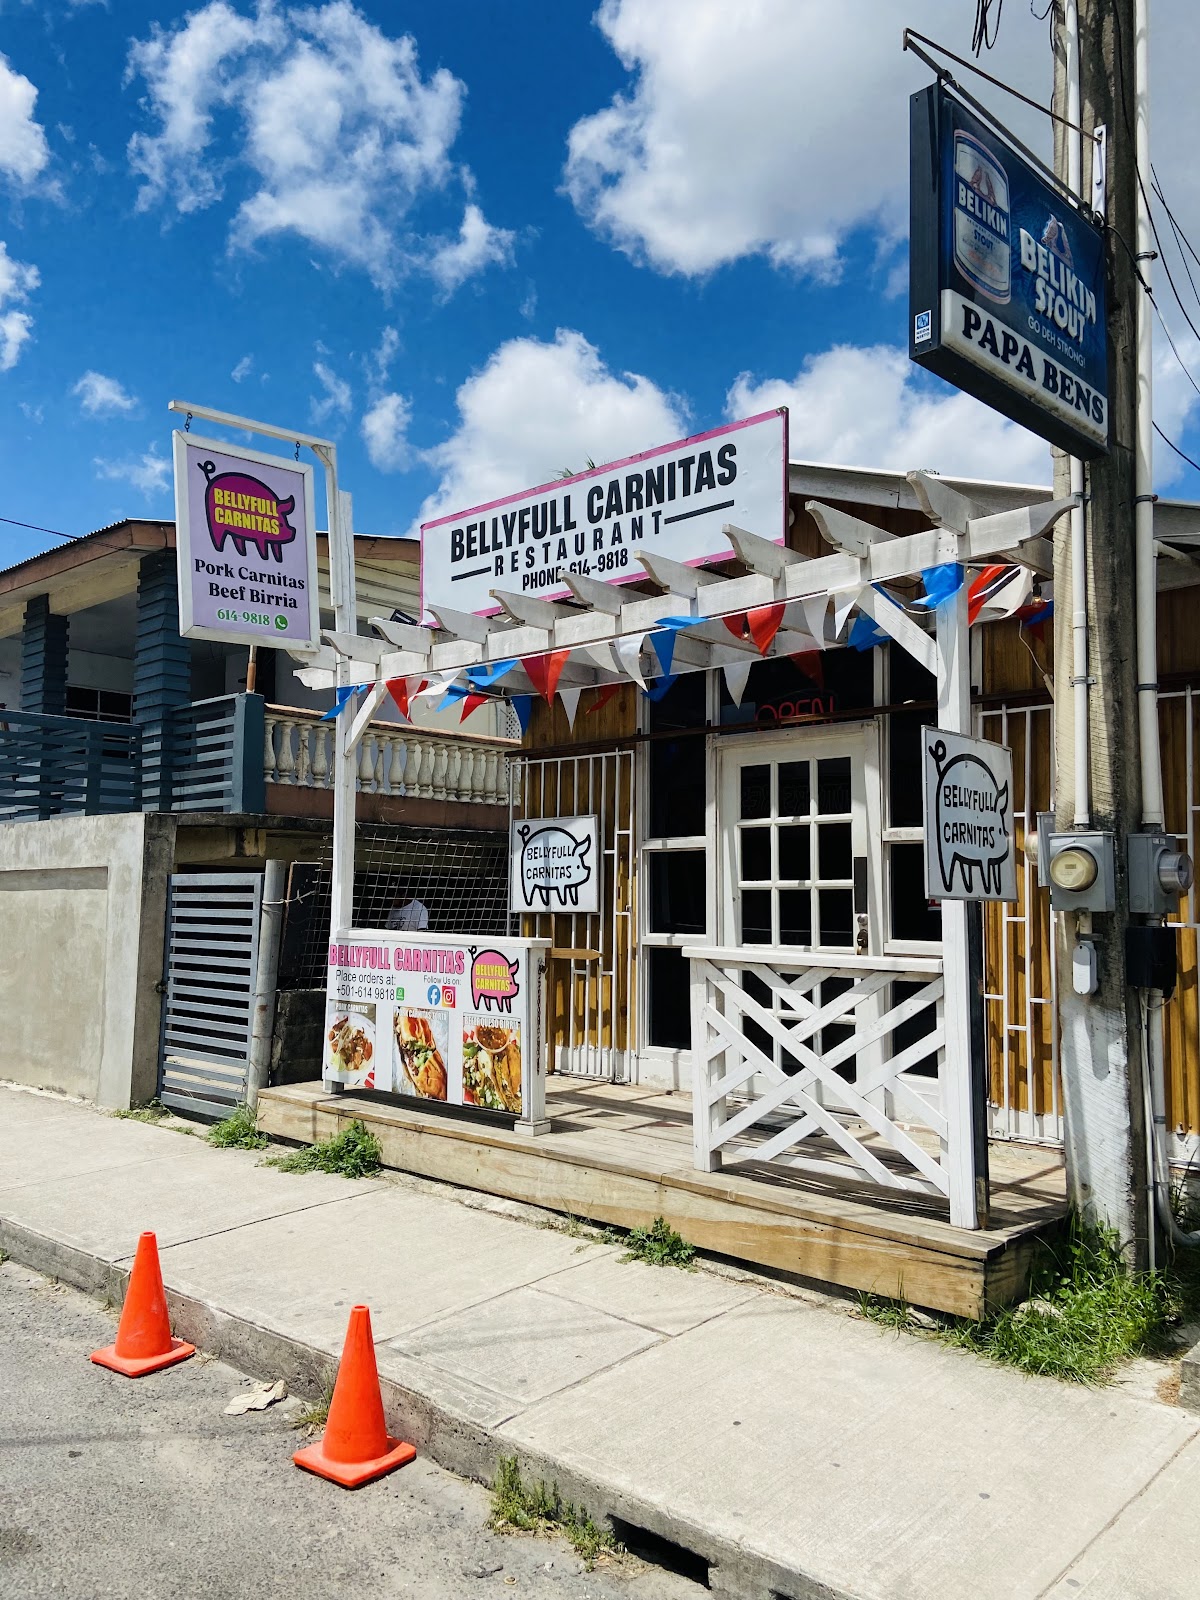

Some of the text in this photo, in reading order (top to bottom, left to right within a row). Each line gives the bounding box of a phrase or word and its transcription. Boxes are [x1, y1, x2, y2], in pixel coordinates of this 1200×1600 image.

[958, 181, 1007, 238] BELIKIN
[973, 229, 994, 250] STOUT
[1019, 227, 1096, 325] BELIKIN
[1035, 277, 1086, 344] STOUT
[1027, 315, 1086, 369] GO DEH STRONG!
[961, 303, 1104, 425] PAPA BENS
[213, 487, 278, 518] BELLYFULL
[450, 443, 737, 563] BELLYFULL CARNITAS
[214, 507, 280, 536] CARNITAS
[494, 510, 663, 577] RESTAURANT
[194, 558, 305, 590] Pork Carnitas
[522, 548, 629, 591] PHONE: 614-9818
[208, 582, 298, 609] Beef Birria
[217, 608, 270, 626] 614-9818
[944, 785, 995, 813] BELLYFULL
[943, 821, 995, 849] CARNITAS
[526, 845, 572, 860] BELLYFULL
[526, 865, 572, 880] CARNITAS
[329, 944, 465, 975] BELLYFULL CARNITAS
[475, 963, 510, 978] BELLYFULL
[335, 969, 397, 986] Place orders at:
[423, 975, 442, 985] Follow
[442, 976, 451, 985] Us
[475, 978, 511, 992] CARNITAS
[336, 985, 395, 1001] +501-614 9818
